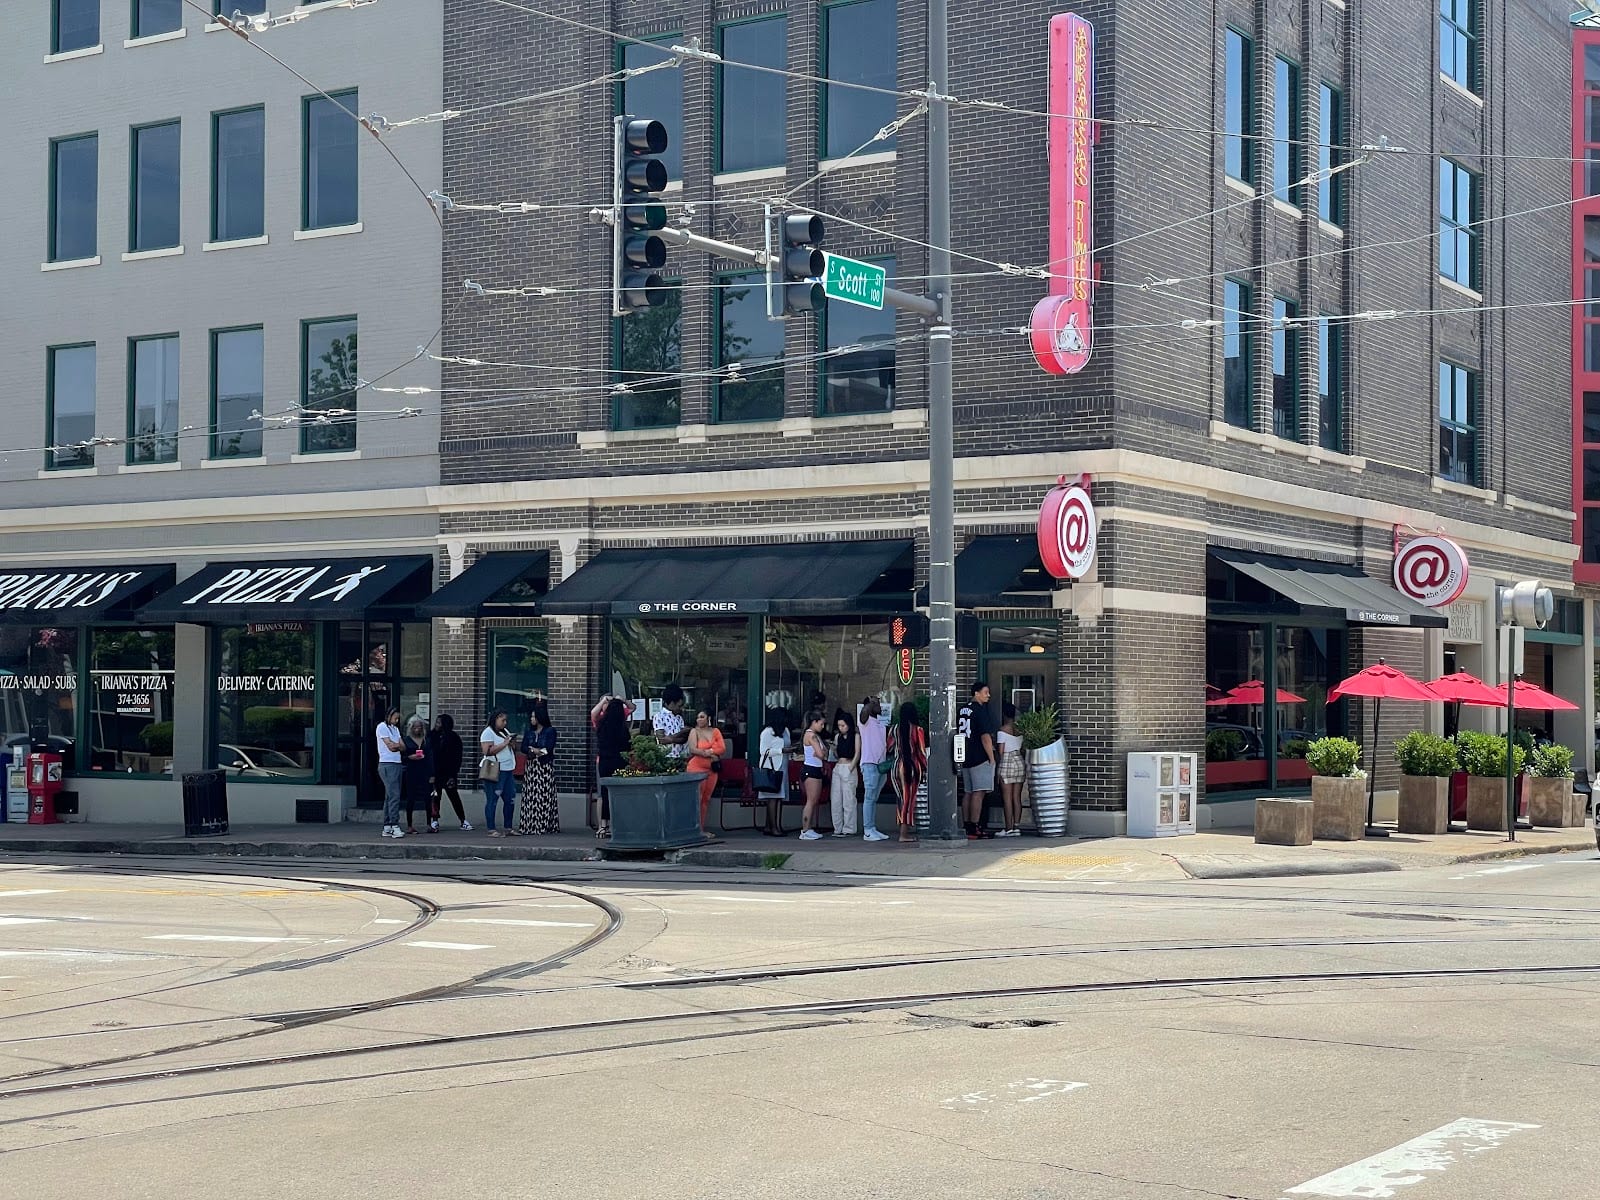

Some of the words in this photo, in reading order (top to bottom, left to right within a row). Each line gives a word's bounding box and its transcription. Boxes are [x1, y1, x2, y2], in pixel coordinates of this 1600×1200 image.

[1074, 200, 1088, 301] TIMES
[831, 261, 835, 274] S
[839, 266, 867, 297] Scott
[870, 288, 881, 302] 100
[1060, 498, 1089, 567] @
[1398, 544, 1450, 600] @
[0, 571, 142, 610] RIANA'S
[182, 565, 332, 604] PIZZA
[638, 603, 651, 613] @
[653, 602, 679, 611] THE
[681, 602, 737, 611] CORNER
[1365, 612, 1377, 621] THE
[1377, 613, 1400, 623] CORNER
[283, 622, 303, 631] PIZZA
[901, 648, 911, 681] PEN
[0, 675, 20, 689] IZZA
[23, 675, 51, 690] SALAD
[54, 675, 77, 690] SUBS
[101, 675, 139, 690] IRIANA'S
[140, 675, 168, 690] PIZZA
[217, 676, 261, 691] DELIVERY
[266, 676, 315, 691] CATERING
[117, 693, 150, 705] 374-3656
